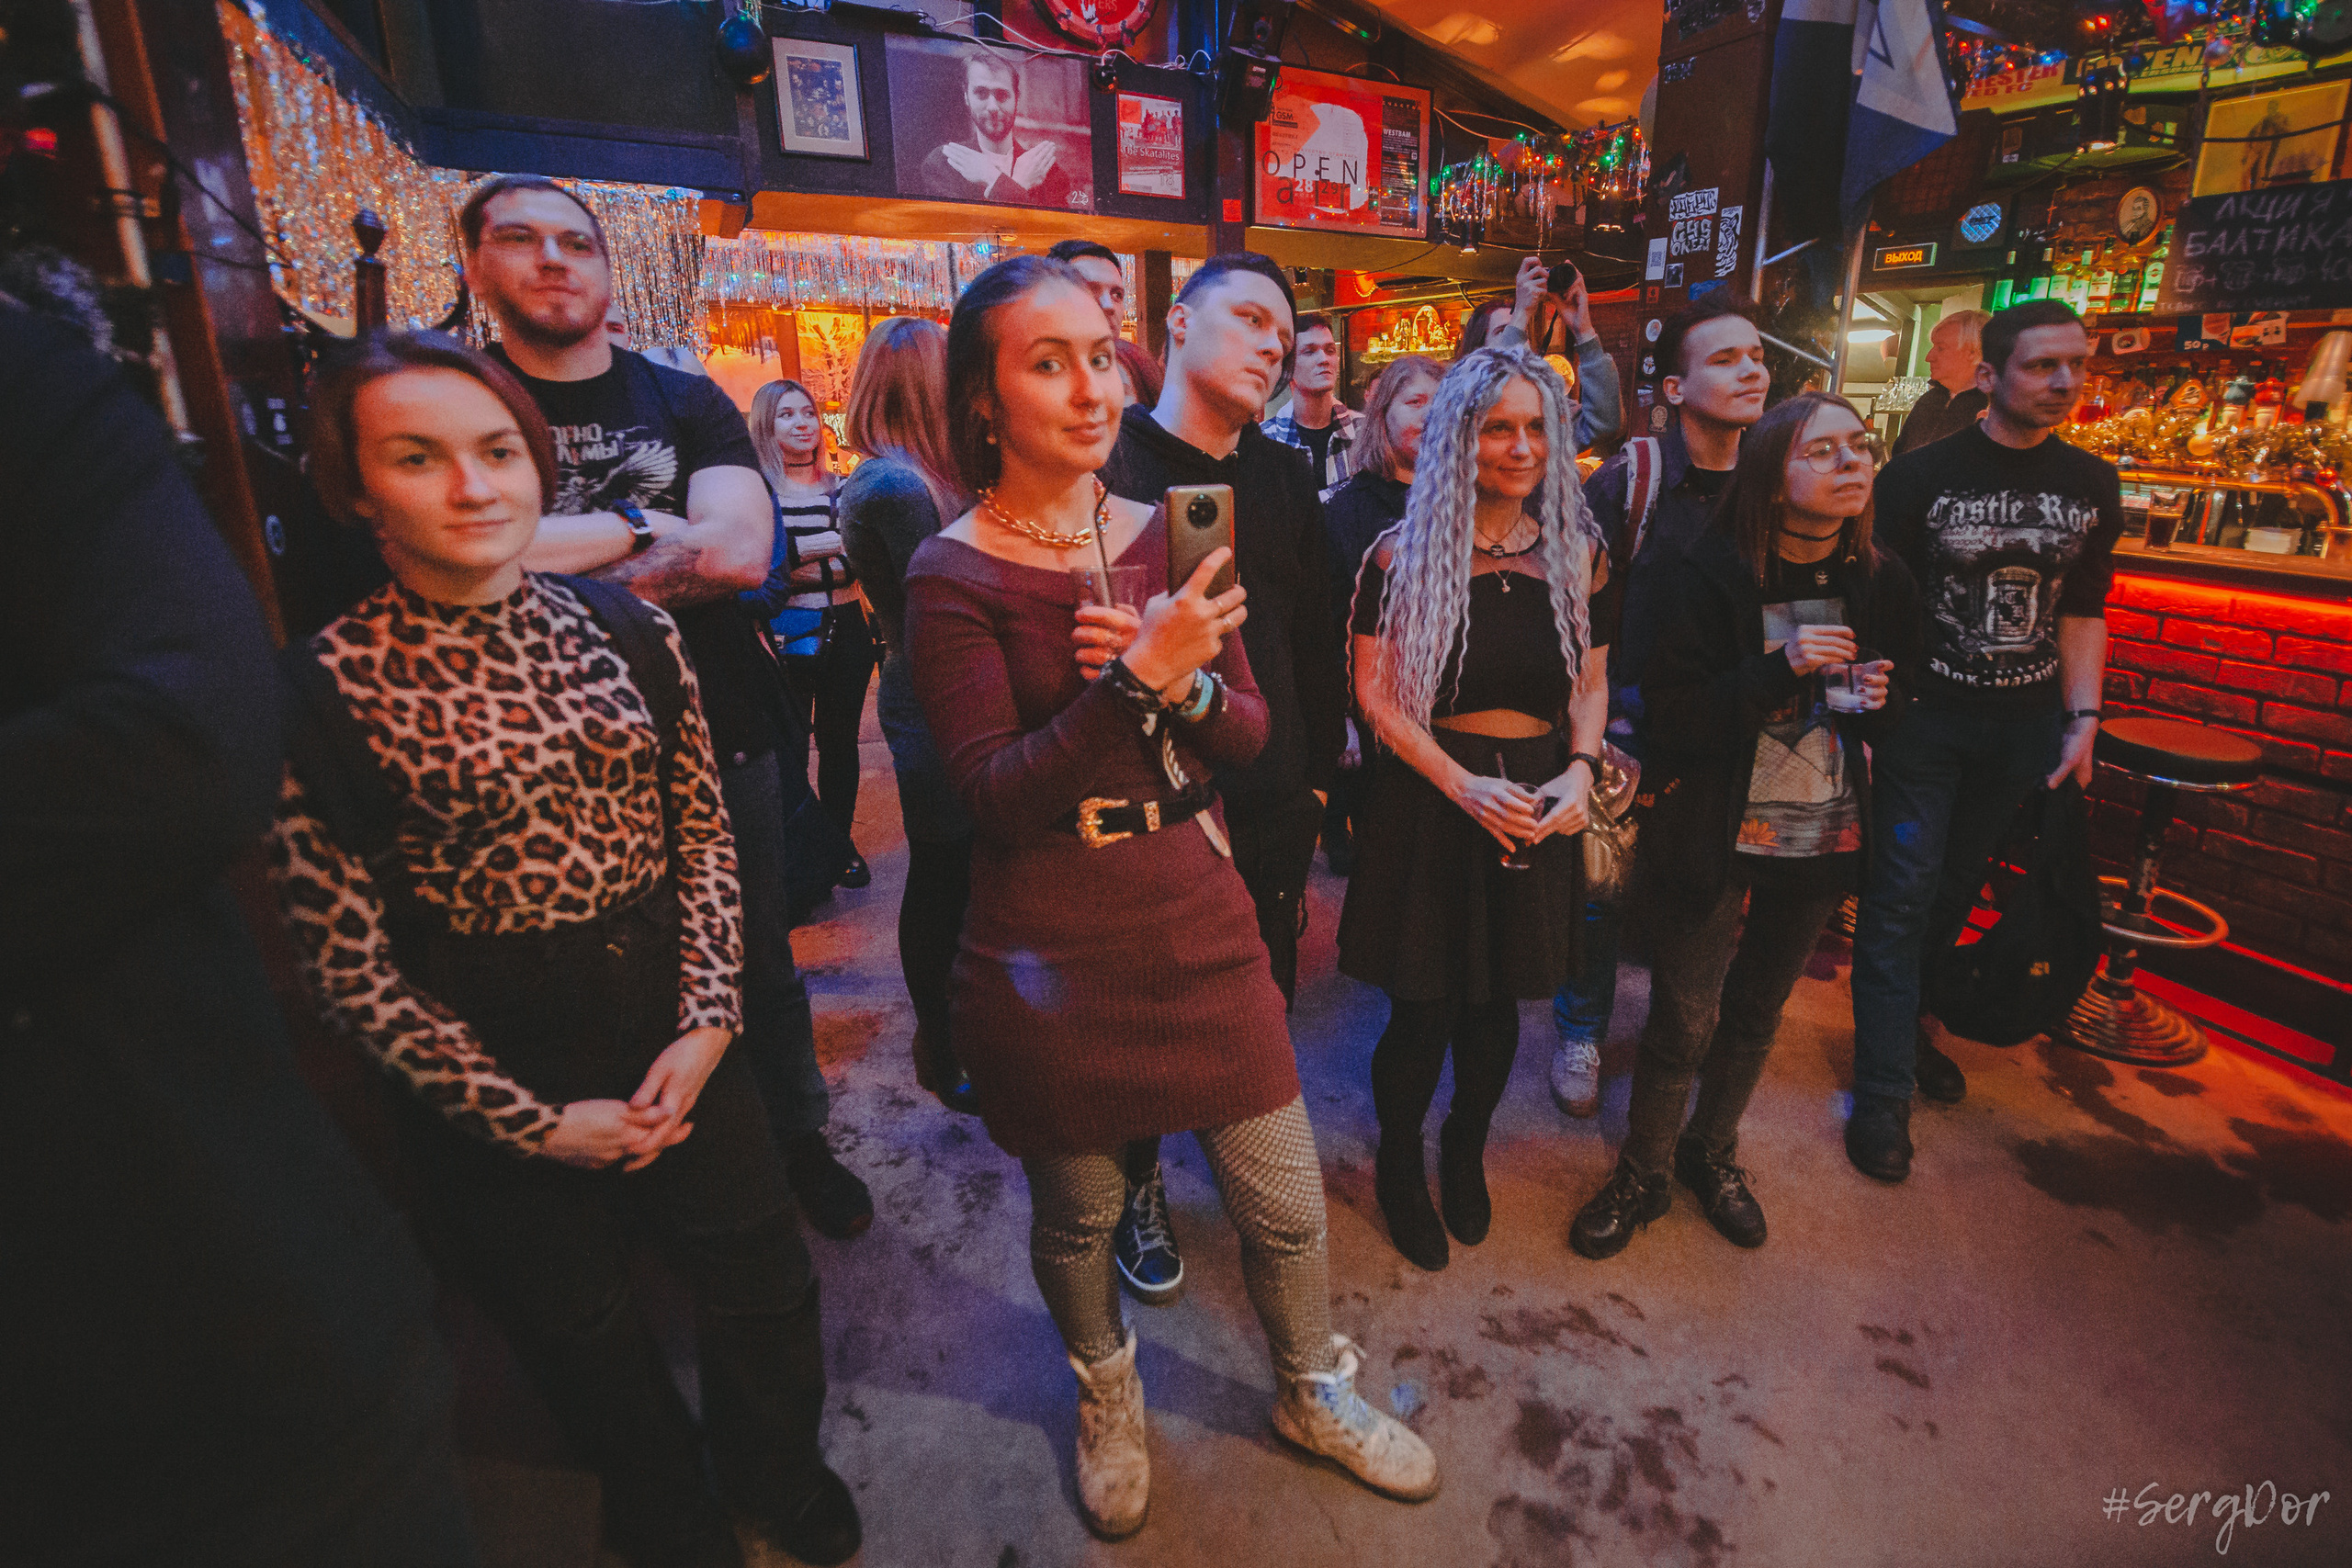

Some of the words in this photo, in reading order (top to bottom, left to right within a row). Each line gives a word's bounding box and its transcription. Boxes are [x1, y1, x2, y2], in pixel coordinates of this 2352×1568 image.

[1973, 65, 2058, 90] ESTER
[1276, 111, 1294, 121] GSM
[1383, 128, 1411, 139] WESTBAM
[1140, 147, 1180, 161] Skatalites
[1261, 150, 1358, 185] OPEN
[1159, 173, 1174, 186] 18
[1295, 178, 1314, 193] 28
[1321, 182, 1339, 194] 29
[1277, 170, 1351, 210] air
[2184, 220, 2352, 258] БАЛТИКА
[1884, 250, 1923, 264] ВЫХОД
[1928, 490, 2024, 529] Castle
